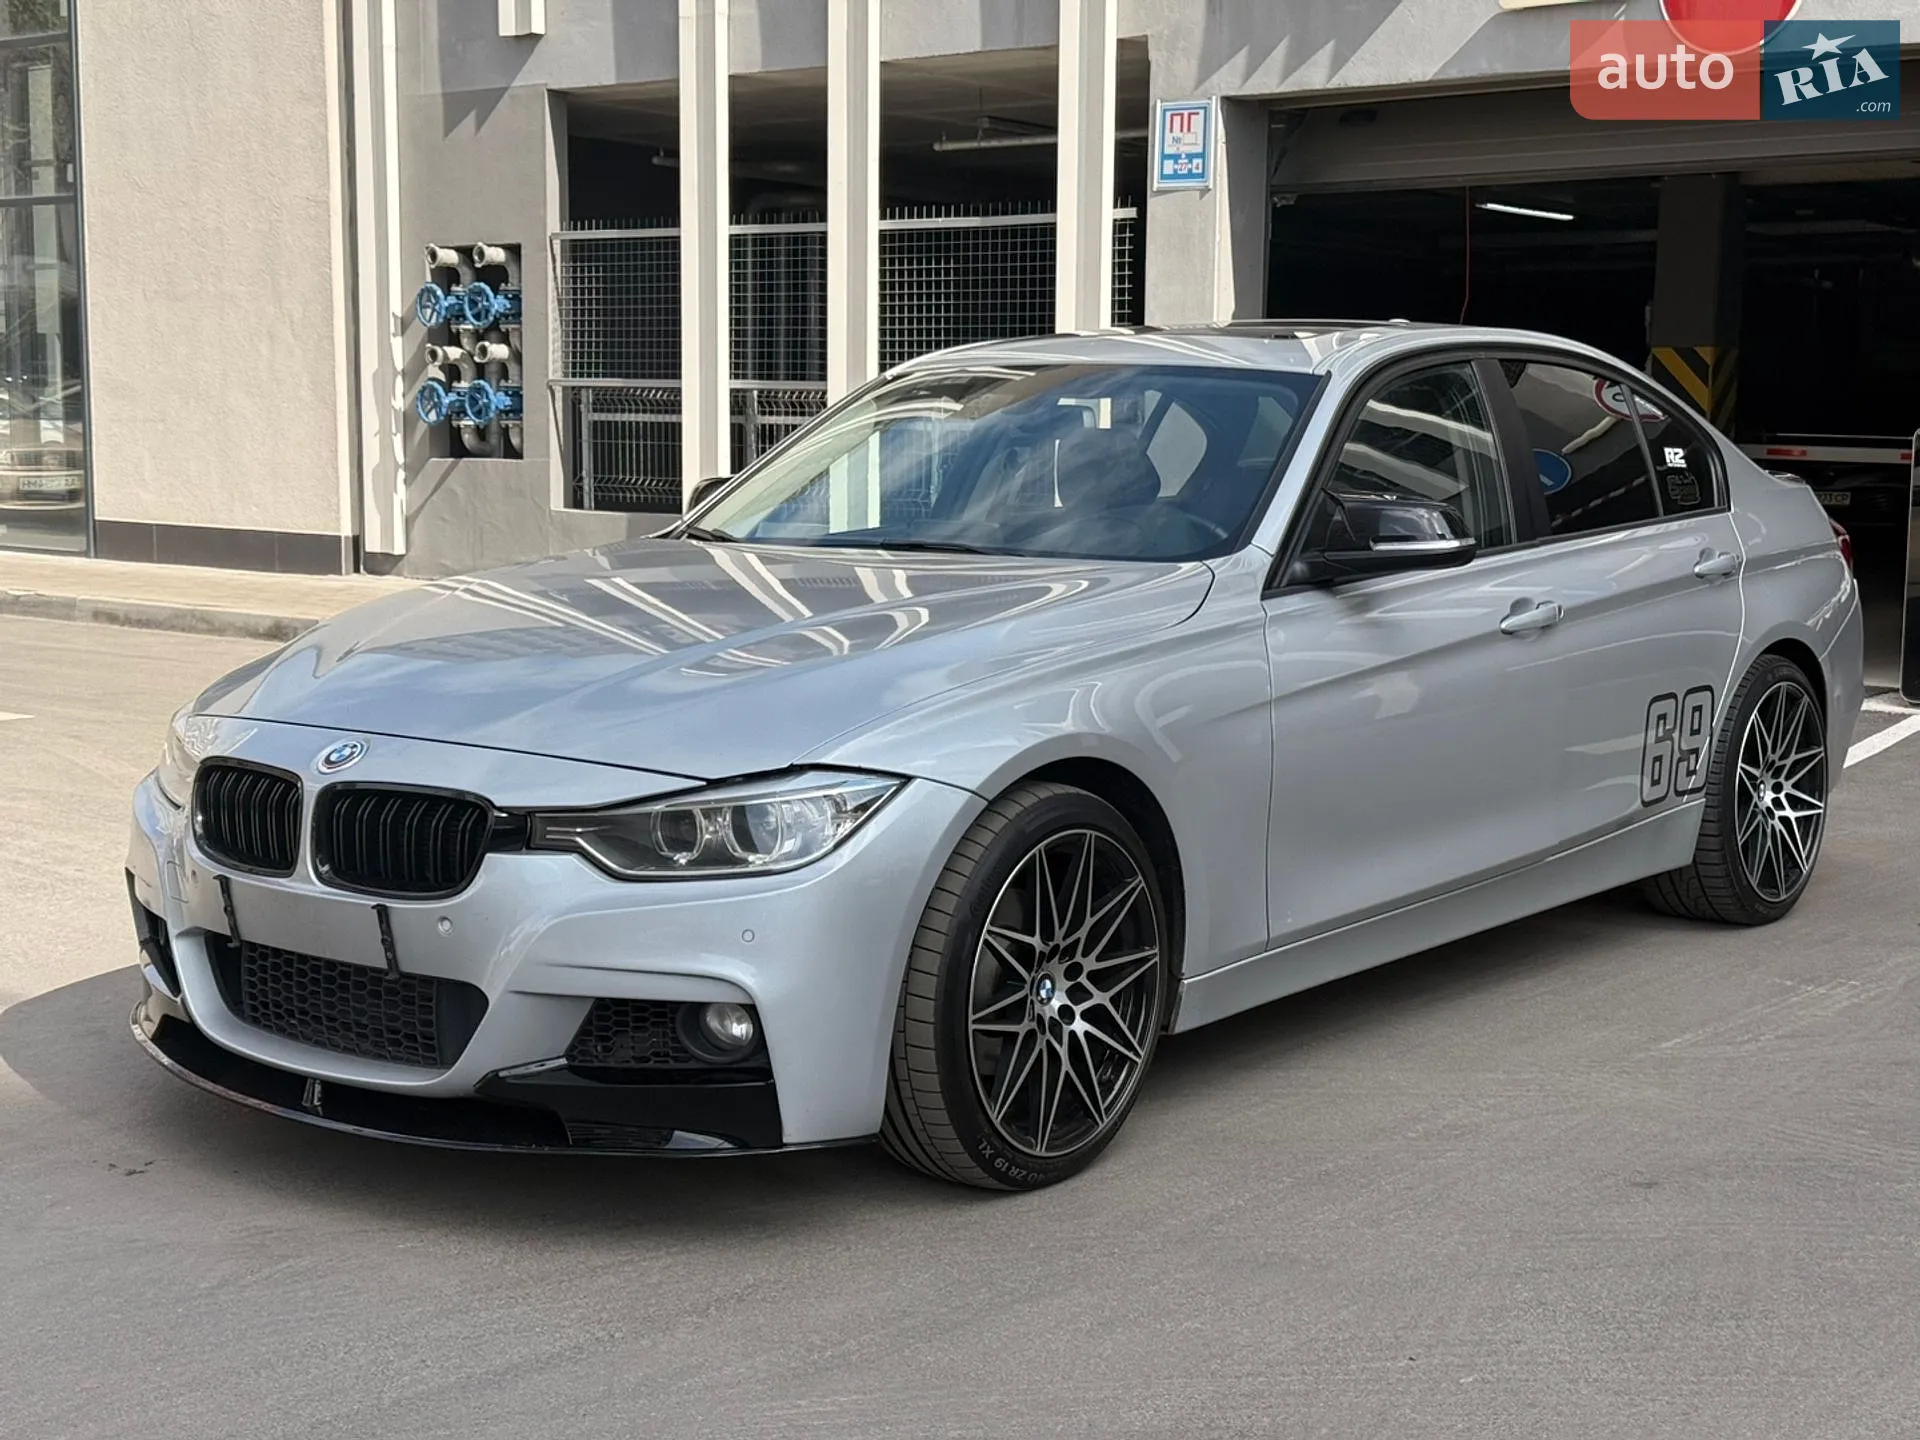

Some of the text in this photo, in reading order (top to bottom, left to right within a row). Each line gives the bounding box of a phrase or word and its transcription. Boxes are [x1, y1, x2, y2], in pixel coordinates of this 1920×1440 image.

[1169, 112, 1200, 133] ПГ
[1663, 447, 1685, 464] R2
[1641, 684, 1715, 807] 69
